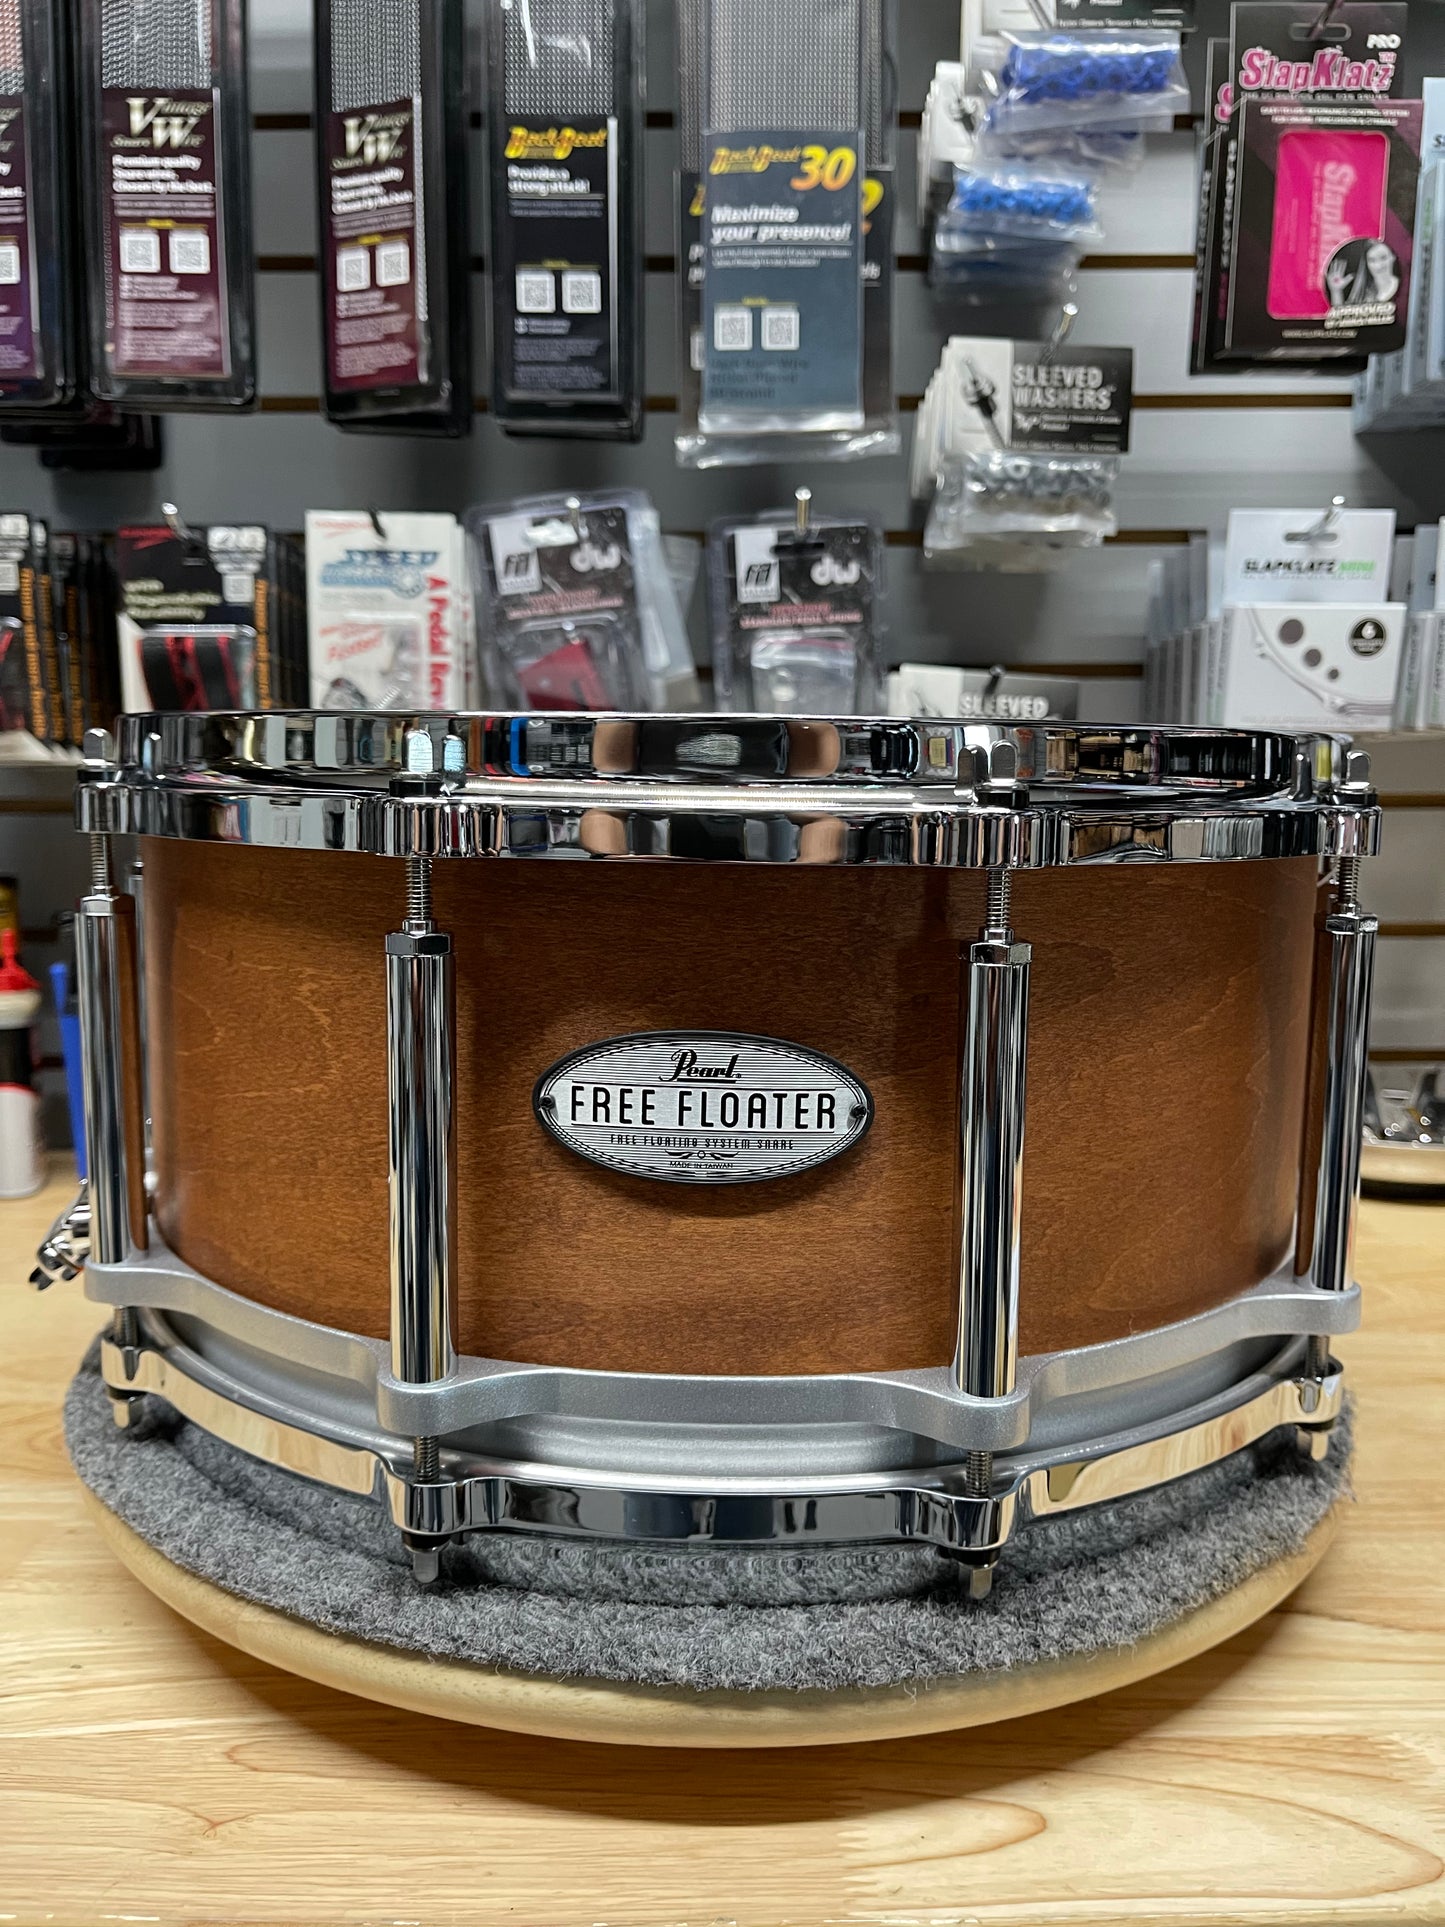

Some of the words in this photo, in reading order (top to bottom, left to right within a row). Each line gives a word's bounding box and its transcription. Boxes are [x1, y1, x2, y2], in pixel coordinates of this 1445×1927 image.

[1367, 34, 1401, 49] PRO
[1240, 48, 1395, 94] SlapKlatz
[790, 145, 857, 191] 30
[711, 203, 800, 224] Maximize
[711, 225, 757, 244] your
[757, 223, 852, 243] presence!
[1013, 364, 1104, 389] SLEEVED
[1013, 386, 1112, 411] WASHERS
[569, 541, 621, 573] dw
[810, 553, 860, 586] dw
[960, 693, 1050, 719] SLEEVED
[659, 1048, 740, 1082] Pearl
[571, 1085, 656, 1126] FREE
[678, 1089, 836, 1130] FLOATER
[611, 1134, 637, 1145] FREE
[644, 1135, 698, 1148] FLOATING
[705, 1138, 750, 1149] SYSTEM
[757, 1139, 794, 1150] SNARE
[669, 1161, 691, 1169] MADE
[704, 1162, 734, 1170] TAIWAN
